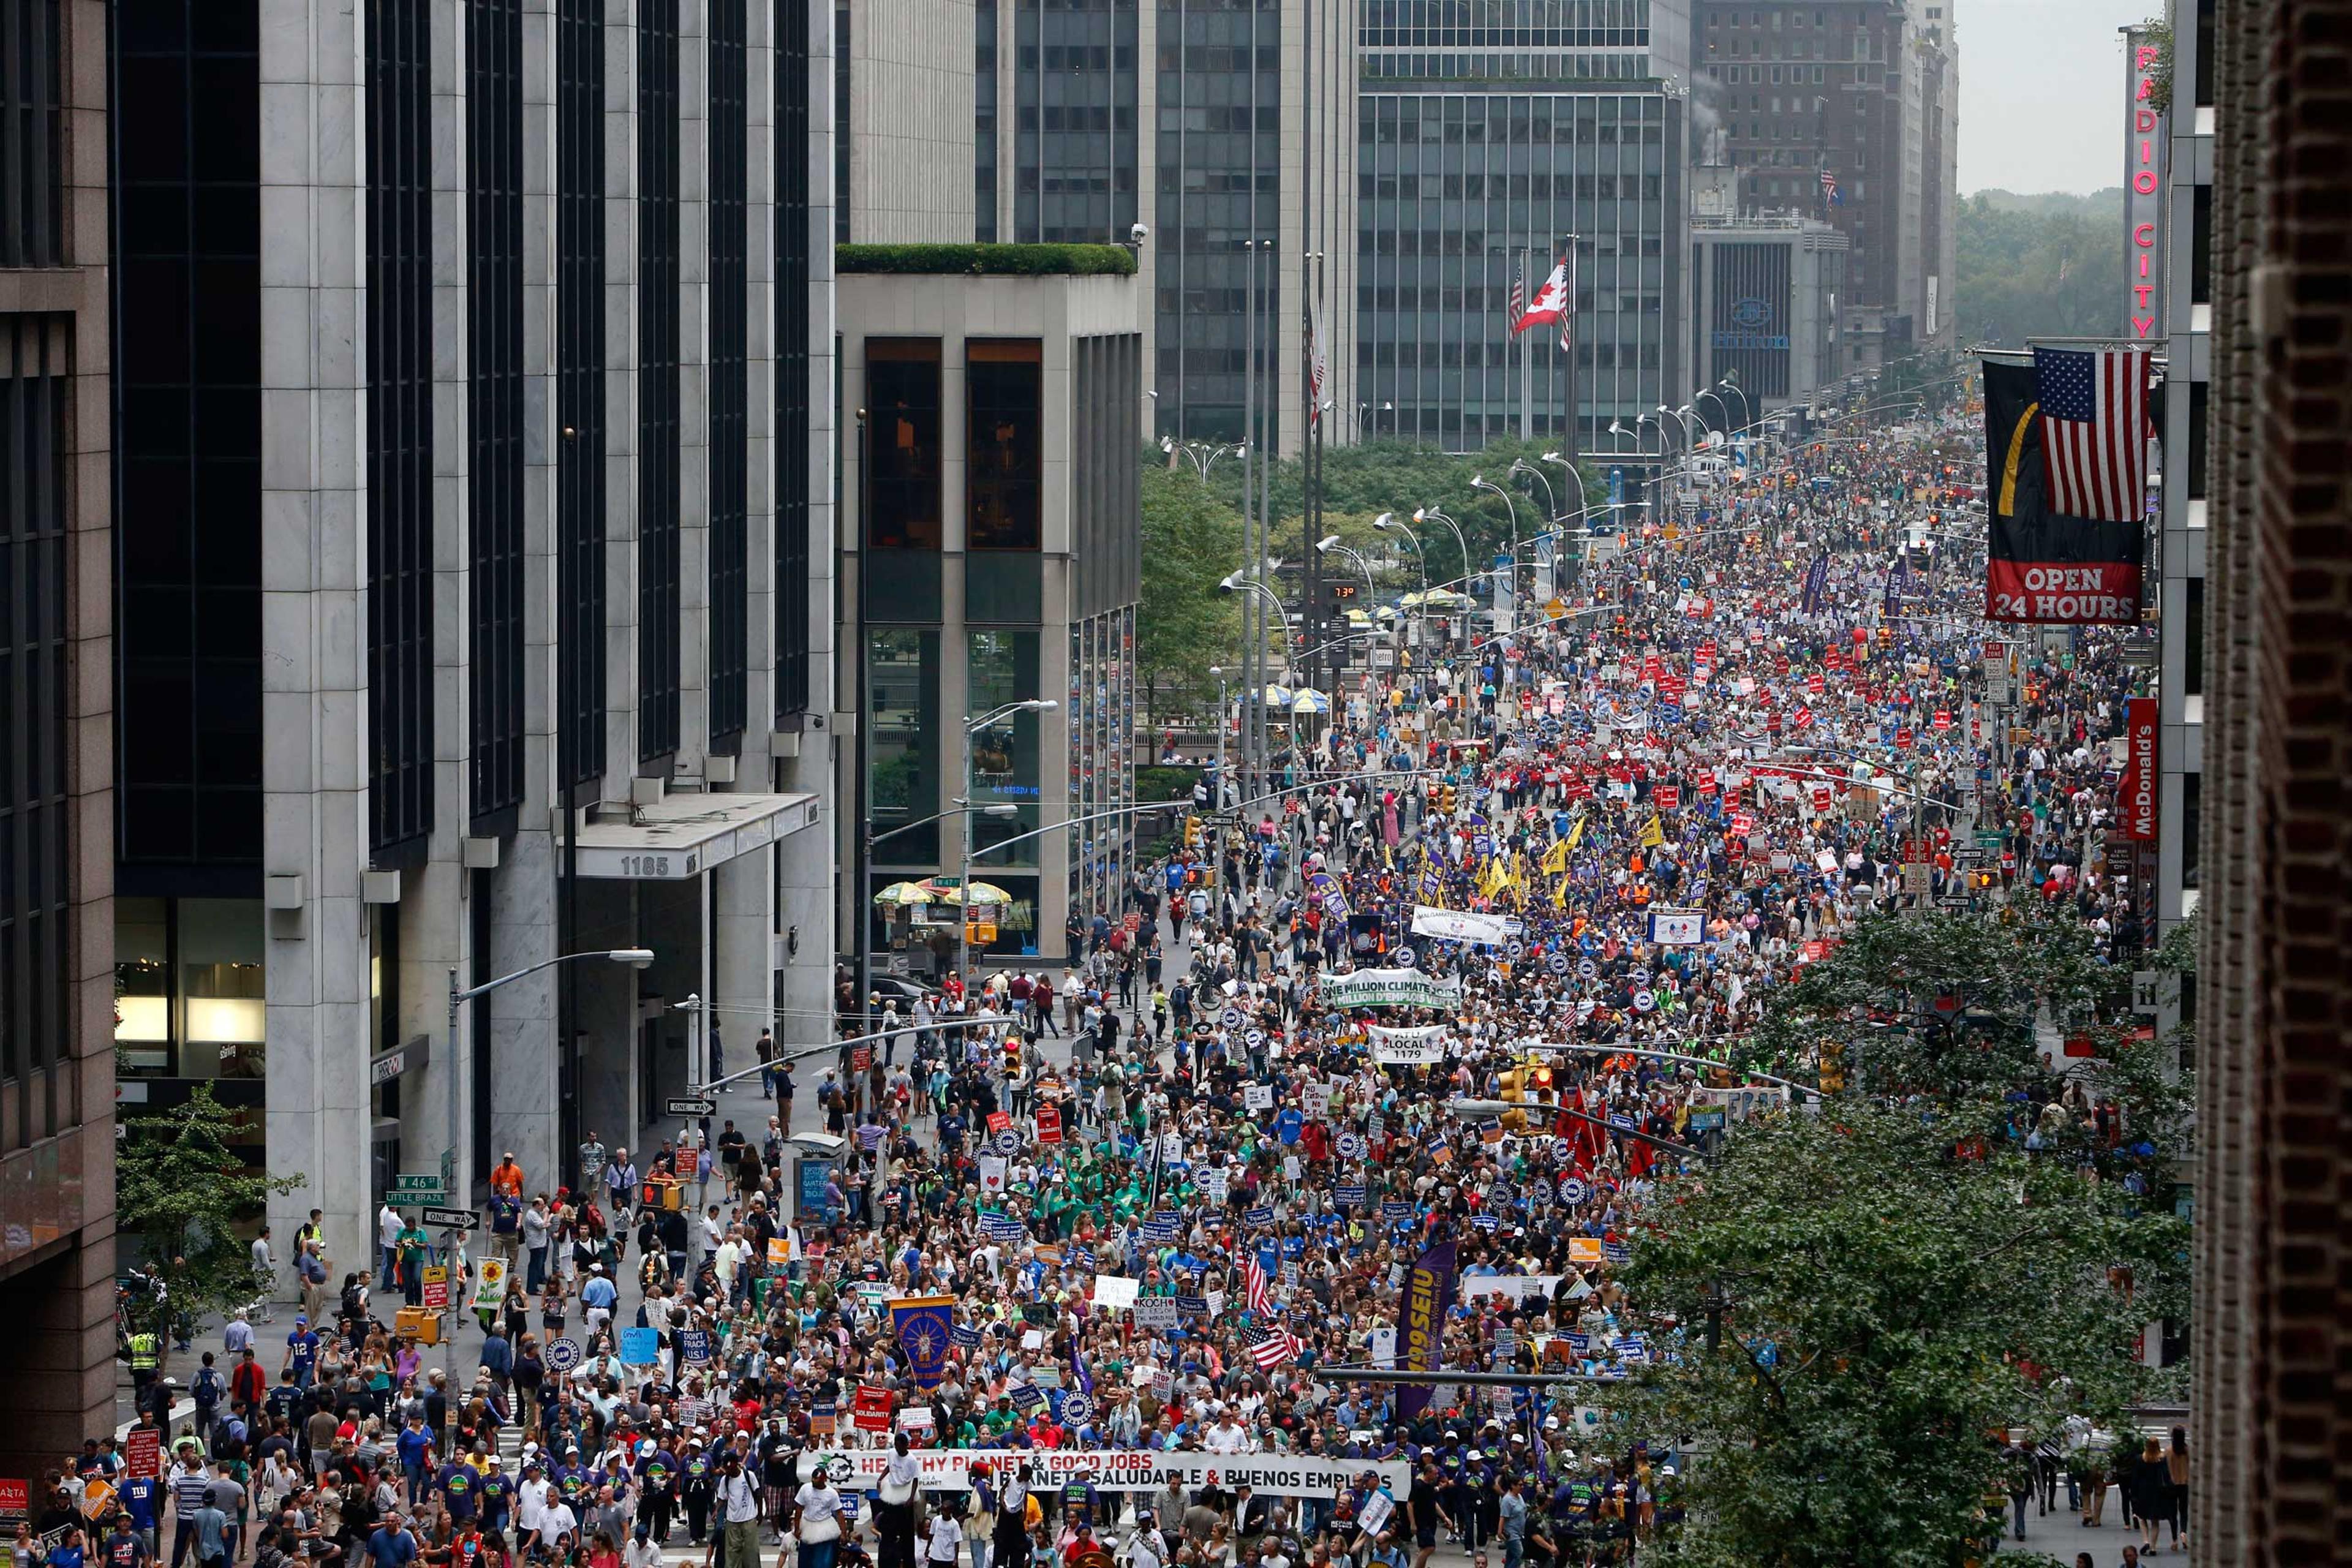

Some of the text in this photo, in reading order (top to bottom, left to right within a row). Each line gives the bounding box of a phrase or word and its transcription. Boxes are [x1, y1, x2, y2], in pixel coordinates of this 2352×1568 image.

[2132, 47, 2158, 338] RADIO CITY
[1712, 328, 1789, 349] Hilton
[2025, 568, 2101, 592] OPEN
[1994, 594, 2134, 620] 24 HOURS
[2135, 725, 2153, 835] McDonald's
[621, 856, 668, 875] 1185
[2139, 865, 2155, 880] BUY
[1460, 913, 1483, 923] TRANSIT
[1484, 920, 1501, 931] UNION
[1322, 982, 1458, 997] ONE MILLION CLIMATE JOBS
[1338, 992, 1458, 1006] MILLION D'EMPLOIS VERTS
[1389, 1040, 1425, 1049] LOCAL
[399, 1177, 407, 1189] W
[412, 1177, 426, 1189] 46
[386, 1192, 444, 1202] LITTLE BRAZIL
[454, 1216, 472, 1224] WAY
[1248, 1218, 1274, 1227] Science
[1139, 1298, 1168, 1308] KOCH
[954, 1331, 975, 1343] Teach
[294, 1343, 307, 1356] 12
[684, 1340, 706, 1348] FRACK
[556, 1350, 570, 1360] UAW
[1153, 1373, 1169, 1382] STOP
[1153, 1381, 1169, 1390] CLIMATE
[1014, 1391, 1036, 1402] Teach
[280, 1401, 290, 1419] 3
[856, 1409, 890, 1419] SOLIDARITY
[1070, 1404, 1084, 1414] UAW
[1032, 1455, 1044, 1470] &
[1049, 1455, 1101, 1471] GOOD
[1105, 1453, 1153, 1470] JOBS
[1207, 1469, 1220, 1485] &
[1226, 1470, 1301, 1487] BUENOS
[132, 1487, 147, 1499] ny
[115, 1549, 132, 1558] TWU
